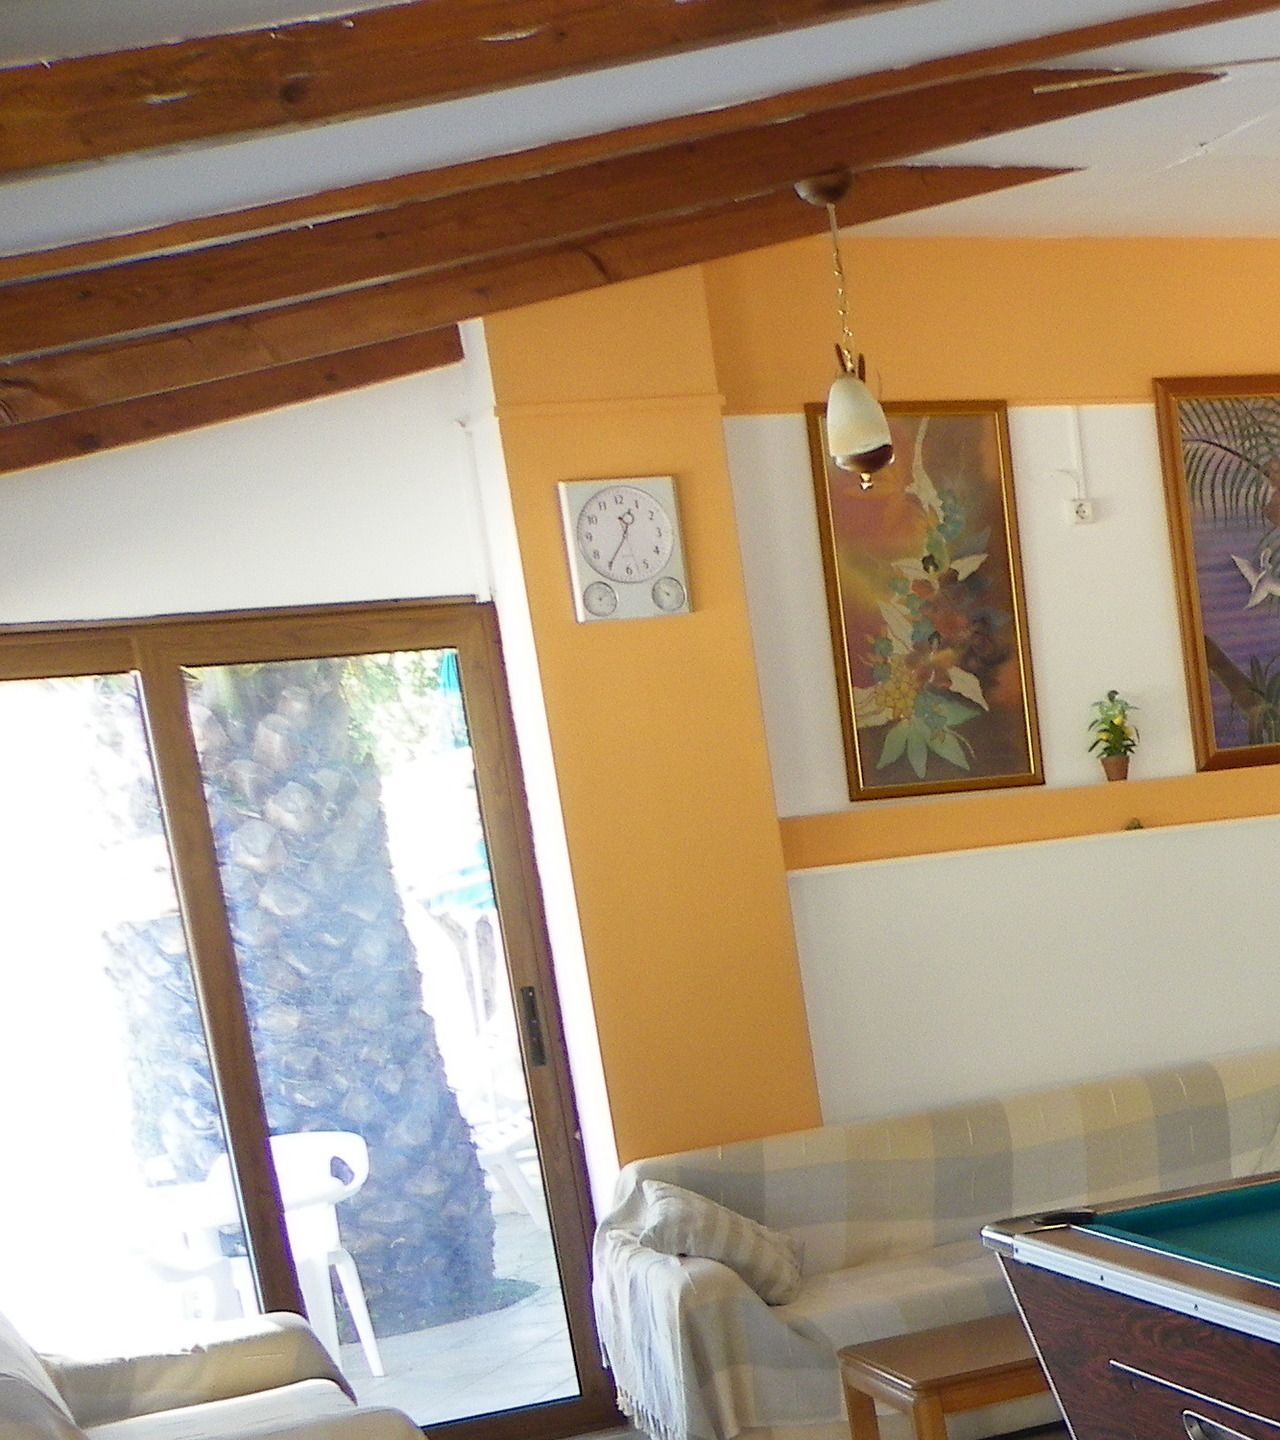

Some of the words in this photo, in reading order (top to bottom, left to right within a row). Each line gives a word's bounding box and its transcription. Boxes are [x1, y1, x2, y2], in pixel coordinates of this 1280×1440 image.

[614, 495, 624, 505] 12
[598, 501, 607, 511] 11
[587, 515, 598, 526] 10
[648, 510, 655, 521] 2
[585, 532, 593, 543] 9
[656, 527, 663, 538] 3
[593, 550, 600, 560] 8
[653, 546, 660, 555] 4
[642, 559, 650, 569] 5
[626, 566, 633, 575] 6
